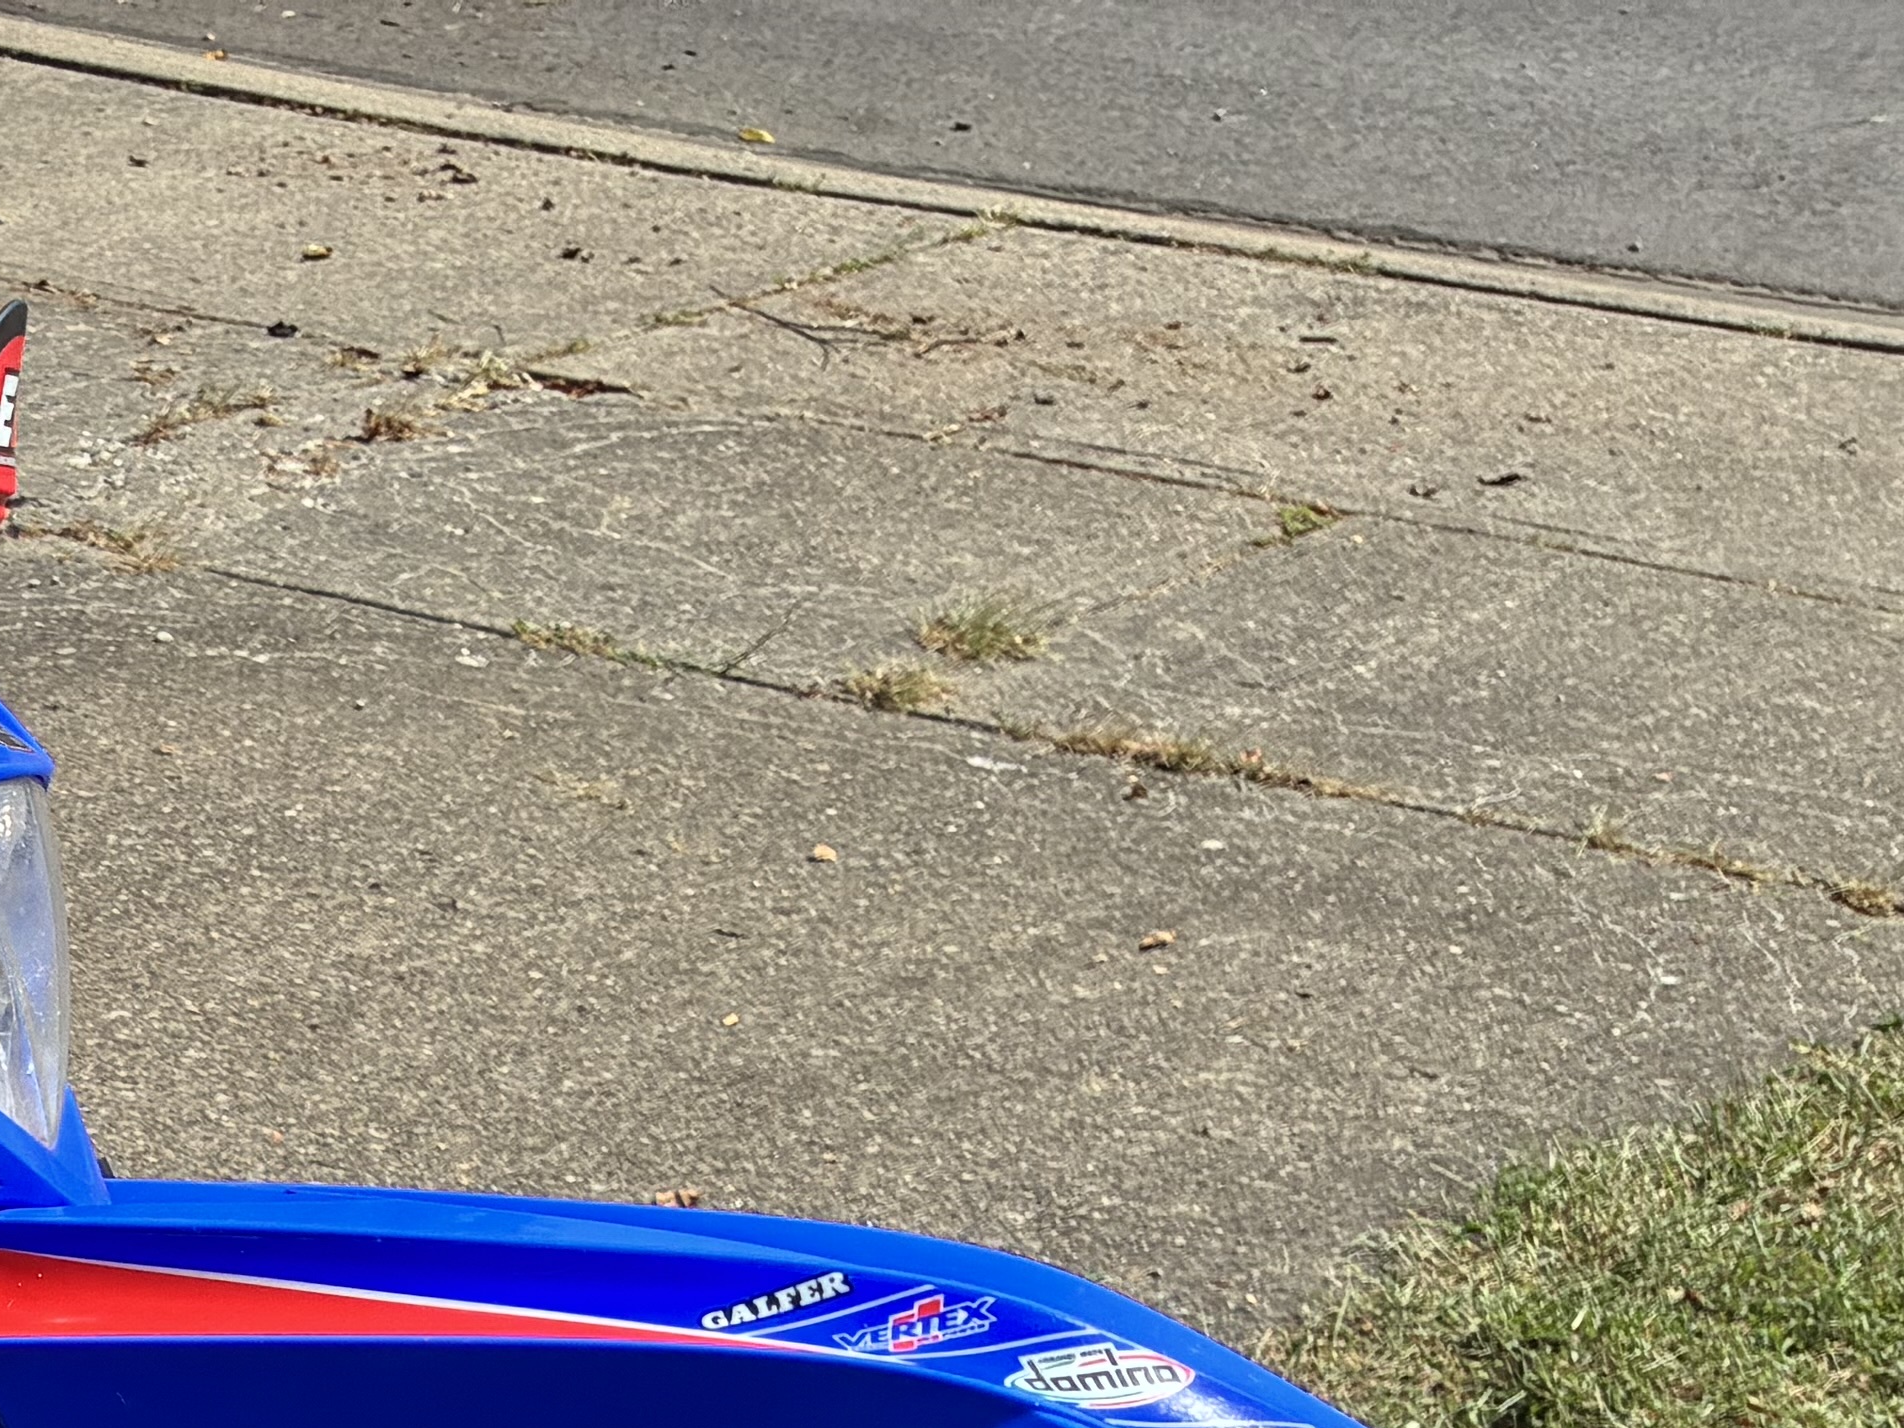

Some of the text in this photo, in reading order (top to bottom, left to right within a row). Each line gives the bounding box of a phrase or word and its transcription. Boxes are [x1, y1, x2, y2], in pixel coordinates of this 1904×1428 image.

[700, 1271, 851, 1331] GALFER
[832, 1297, 995, 1351] VERTEX
[1024, 1347, 1183, 1392] domino
